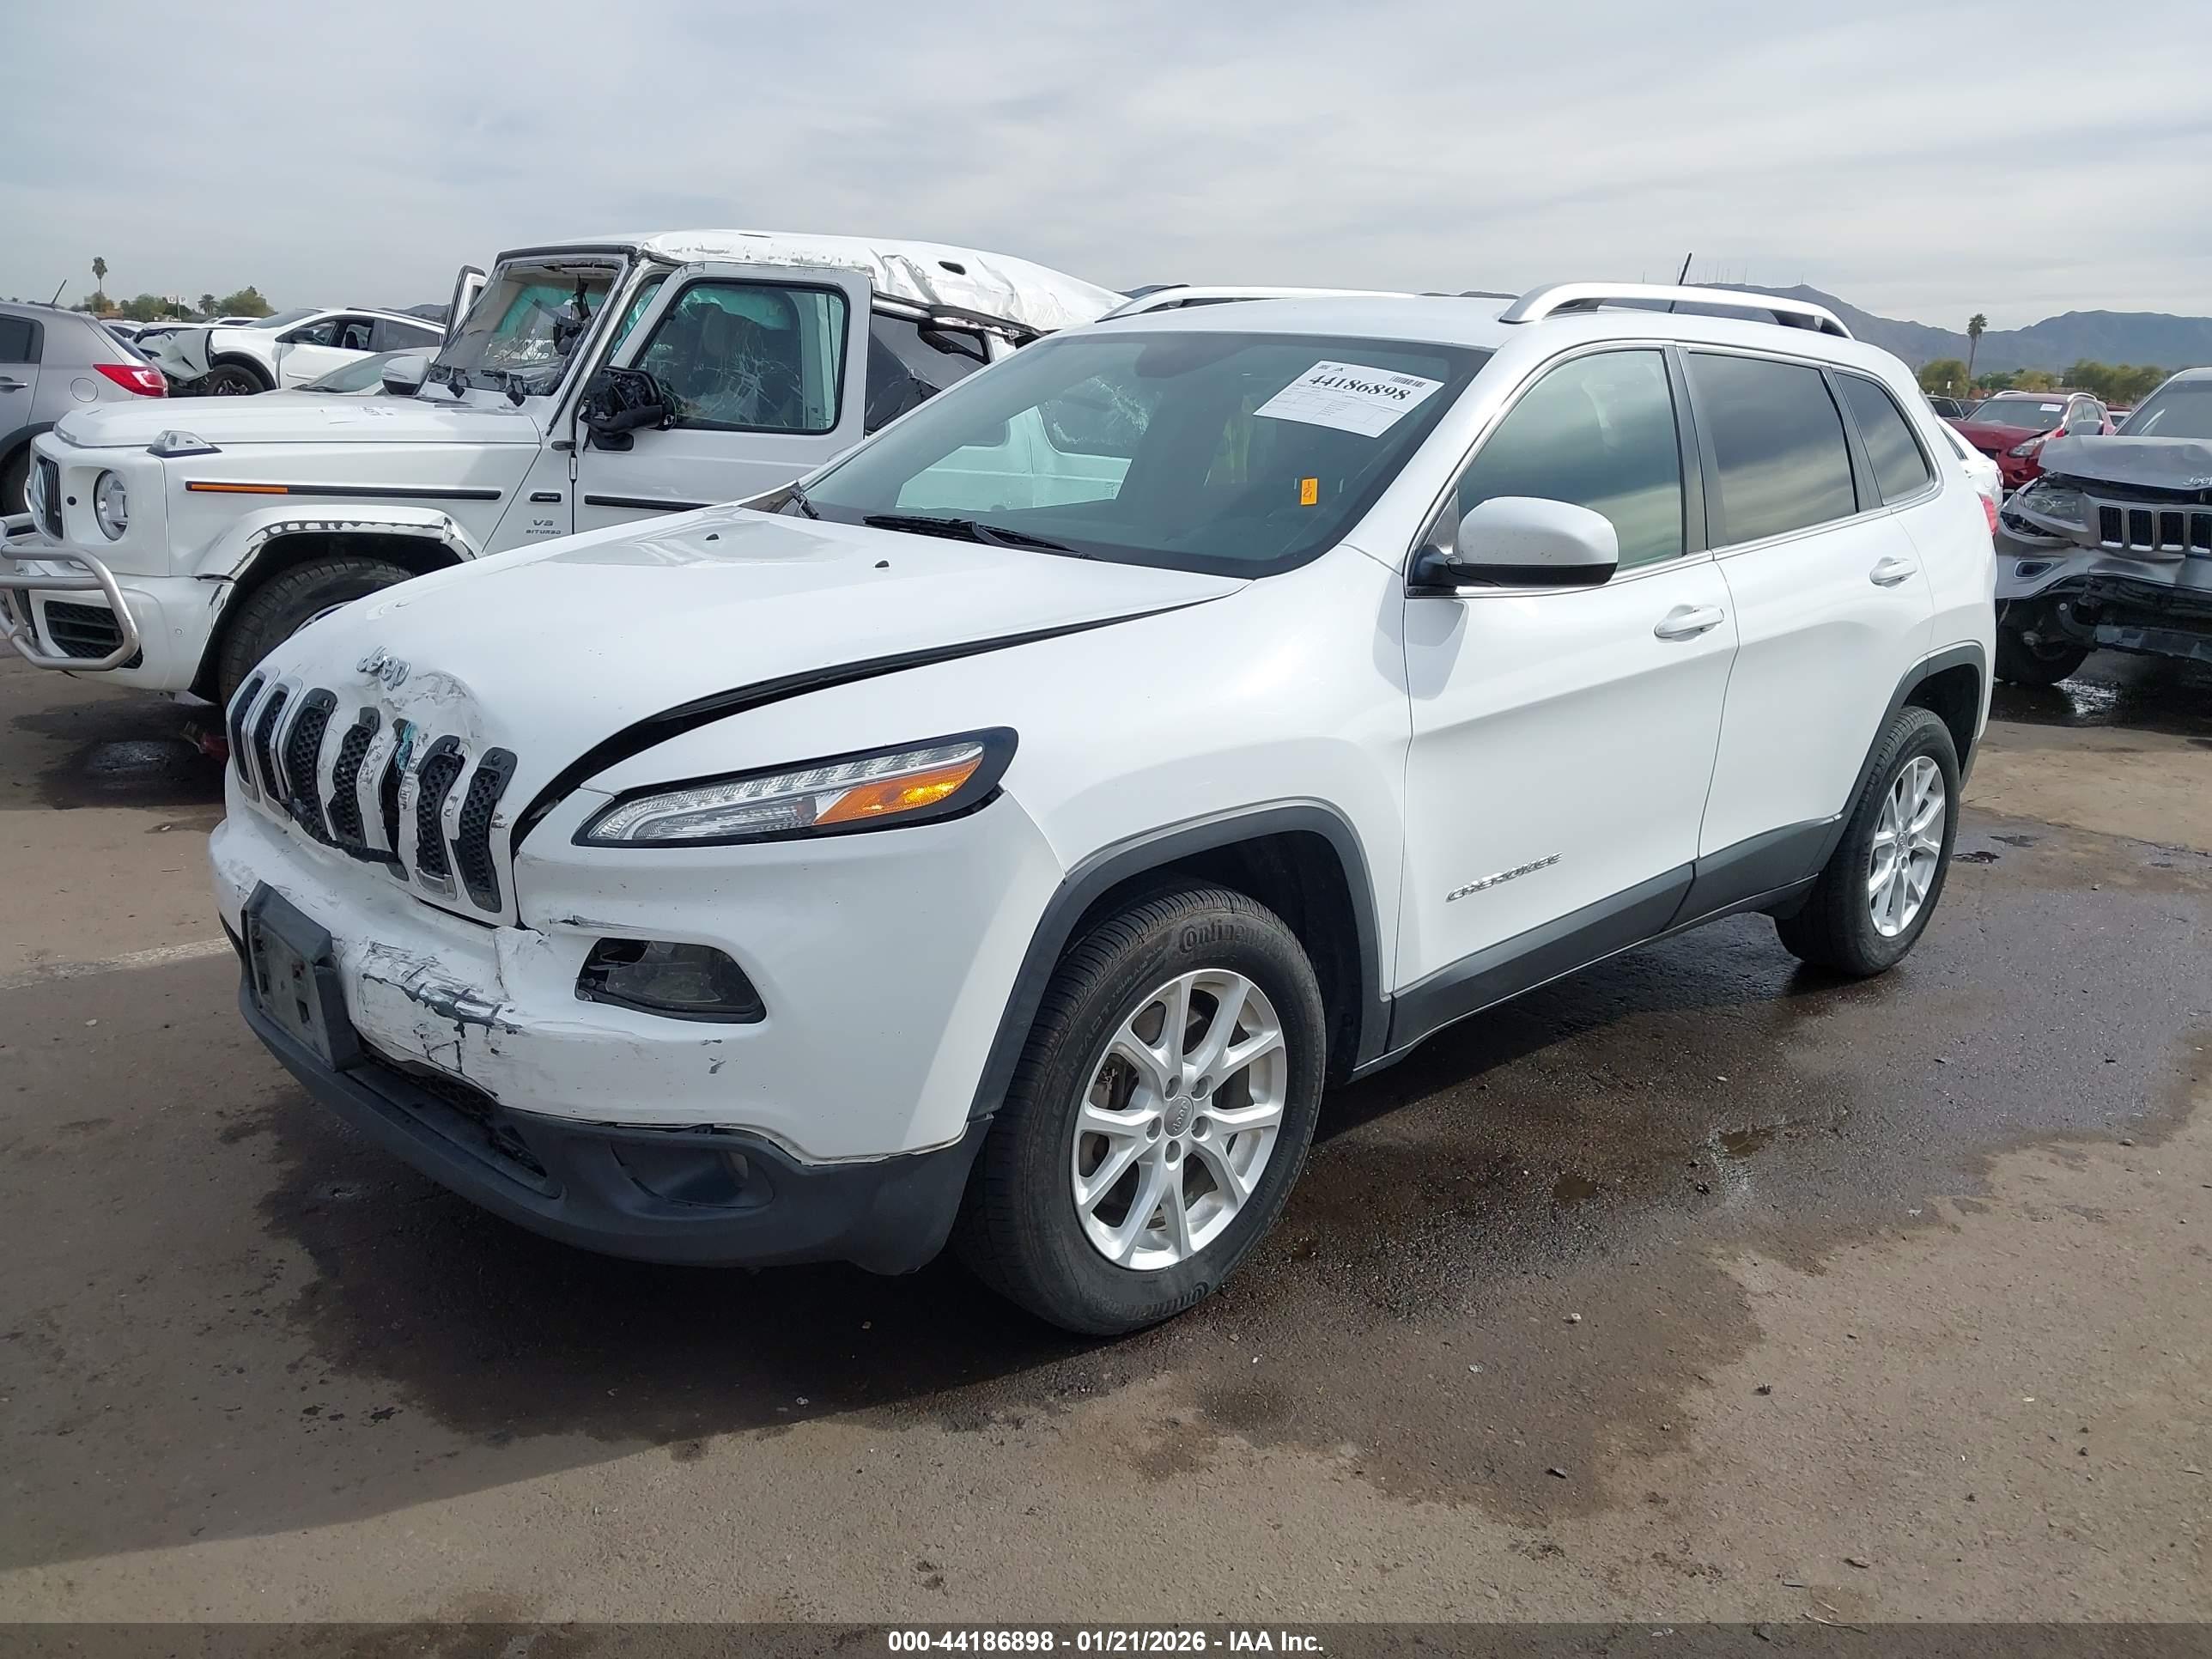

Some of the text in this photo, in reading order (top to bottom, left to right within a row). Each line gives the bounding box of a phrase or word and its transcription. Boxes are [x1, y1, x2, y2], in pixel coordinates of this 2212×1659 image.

[1309, 374, 1412, 401] 44186898
[356, 645, 411, 692] Jeep
[1446, 851, 1563, 902] CHEROKEE
